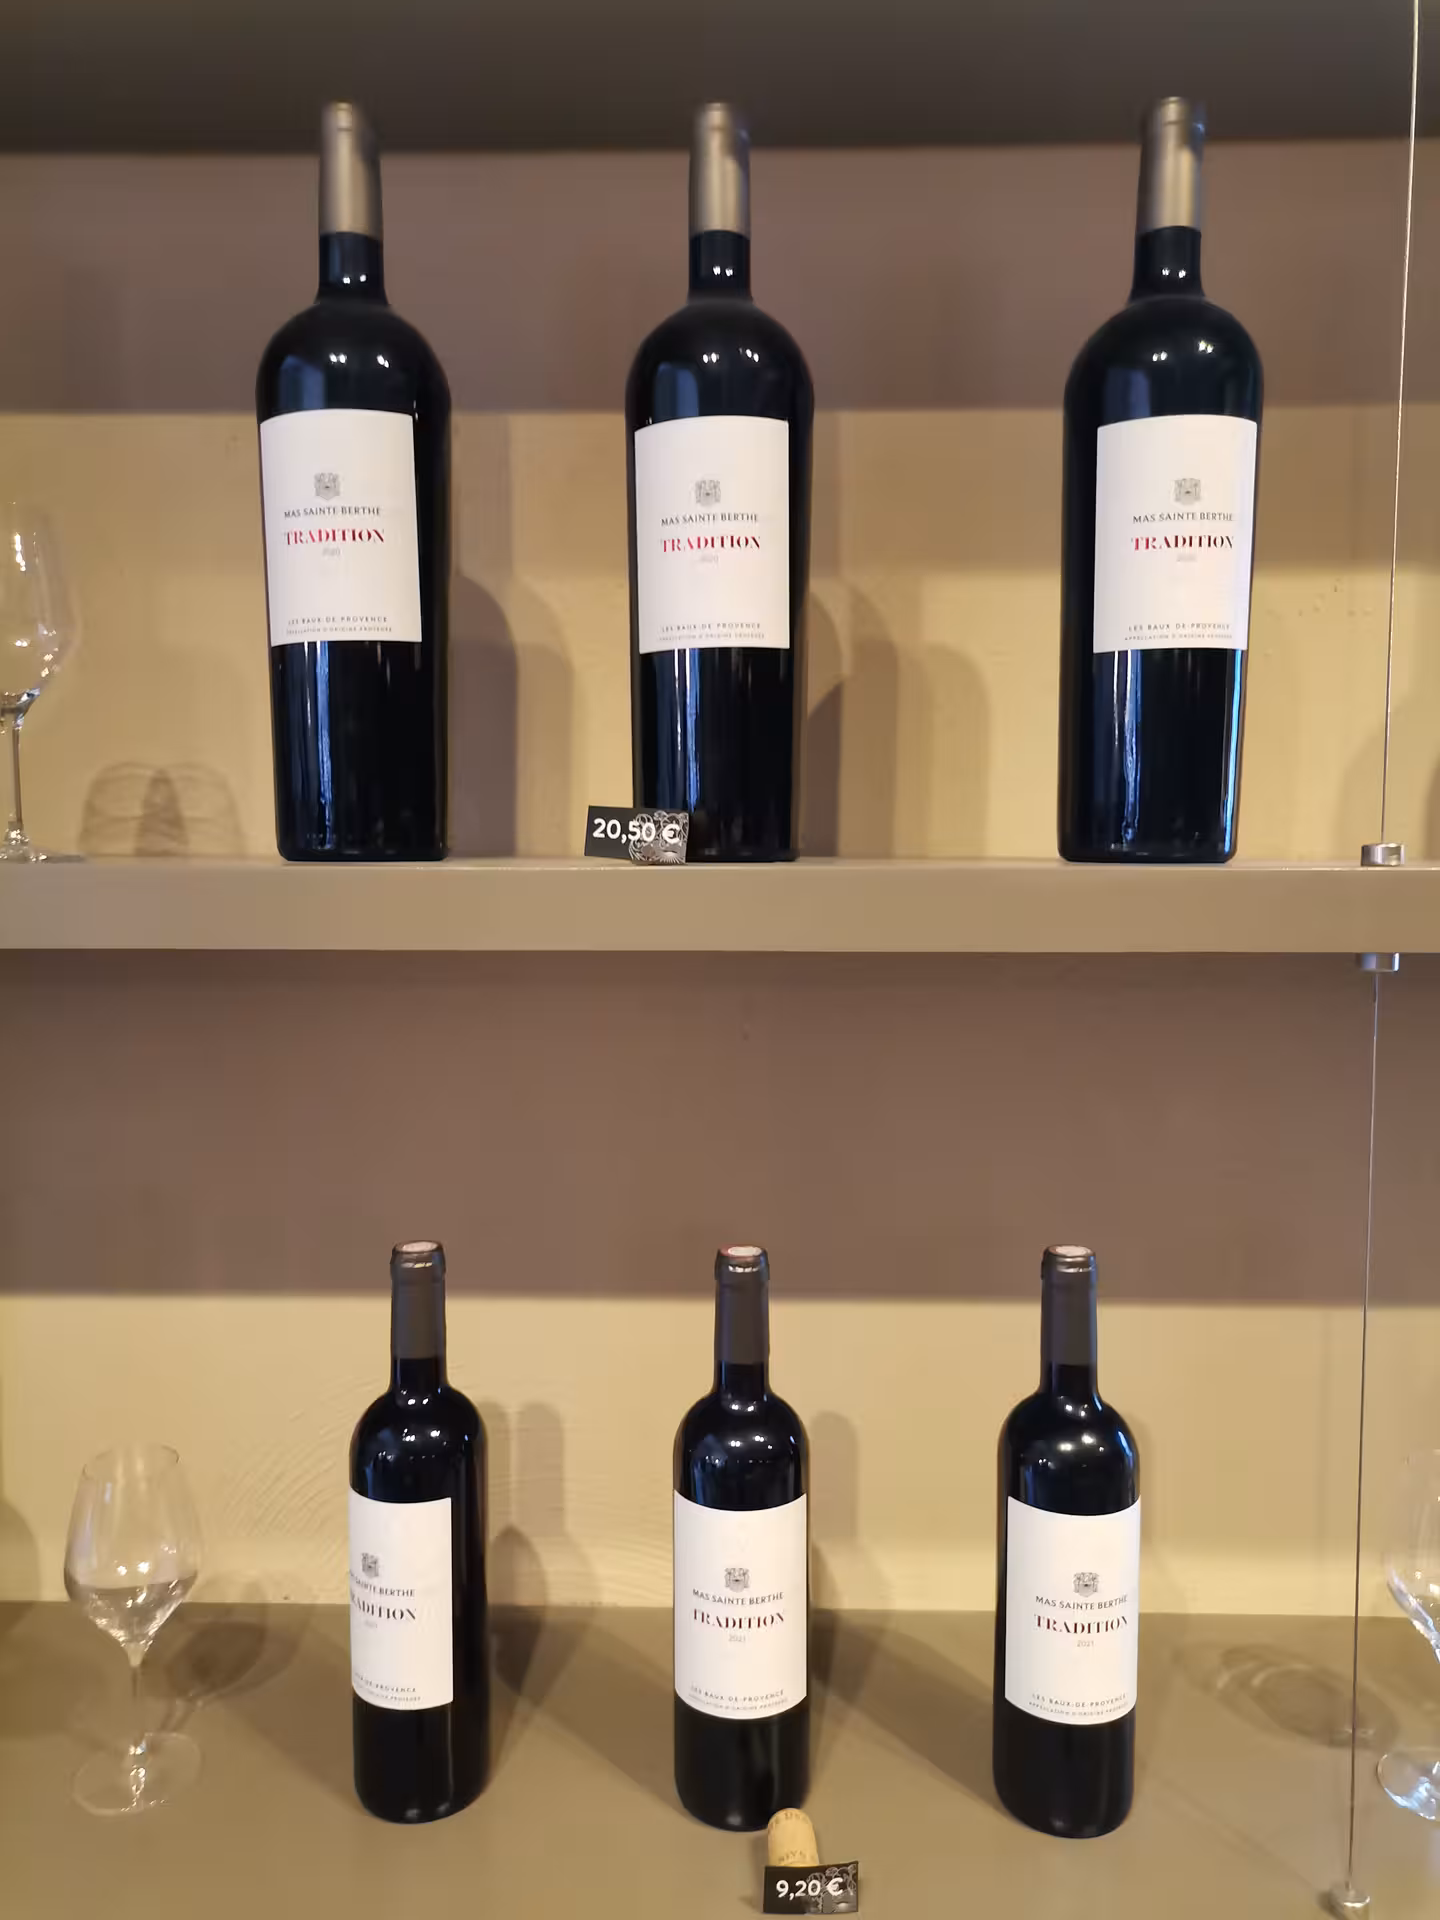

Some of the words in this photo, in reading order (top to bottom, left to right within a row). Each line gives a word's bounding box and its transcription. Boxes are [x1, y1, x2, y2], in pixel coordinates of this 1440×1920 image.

[284, 509, 301, 518] MAS
[303, 506, 336, 516] SAINTE
[341, 506, 380, 516] BERTHE
[661, 518, 679, 526] MAS
[682, 513, 716, 523] SAINTE
[720, 512, 758, 522] BERTHE
[1133, 514, 1155, 524] MAS
[1159, 512, 1196, 521] SAINTE
[1199, 512, 1233, 521] BERTHE
[284, 528, 385, 545] TRADITION
[660, 535, 761, 552] TRADITION
[1131, 535, 1234, 551] TRADITION
[592, 817, 656, 844] 20,50
[661, 823, 681, 844] €
[379, 1586, 415, 1597] BERTHE
[693, 1588, 710, 1601] MAS
[712, 1595, 746, 1606] SAINTE
[749, 1592, 784, 1606] BERTHE
[350, 1590, 417, 1621] RADITION
[1035, 1595, 1057, 1607] MAS
[1059, 1600, 1095, 1610] SAINTE
[1097, 1593, 1128, 1610] BERTHE
[691, 1608, 784, 1630] TRADITION
[1033, 1614, 1128, 1634] TRADITION
[1076, 1639, 1095, 1648] 2021
[775, 1879, 821, 1901] 9,20
[826, 1877, 844, 1896] €
